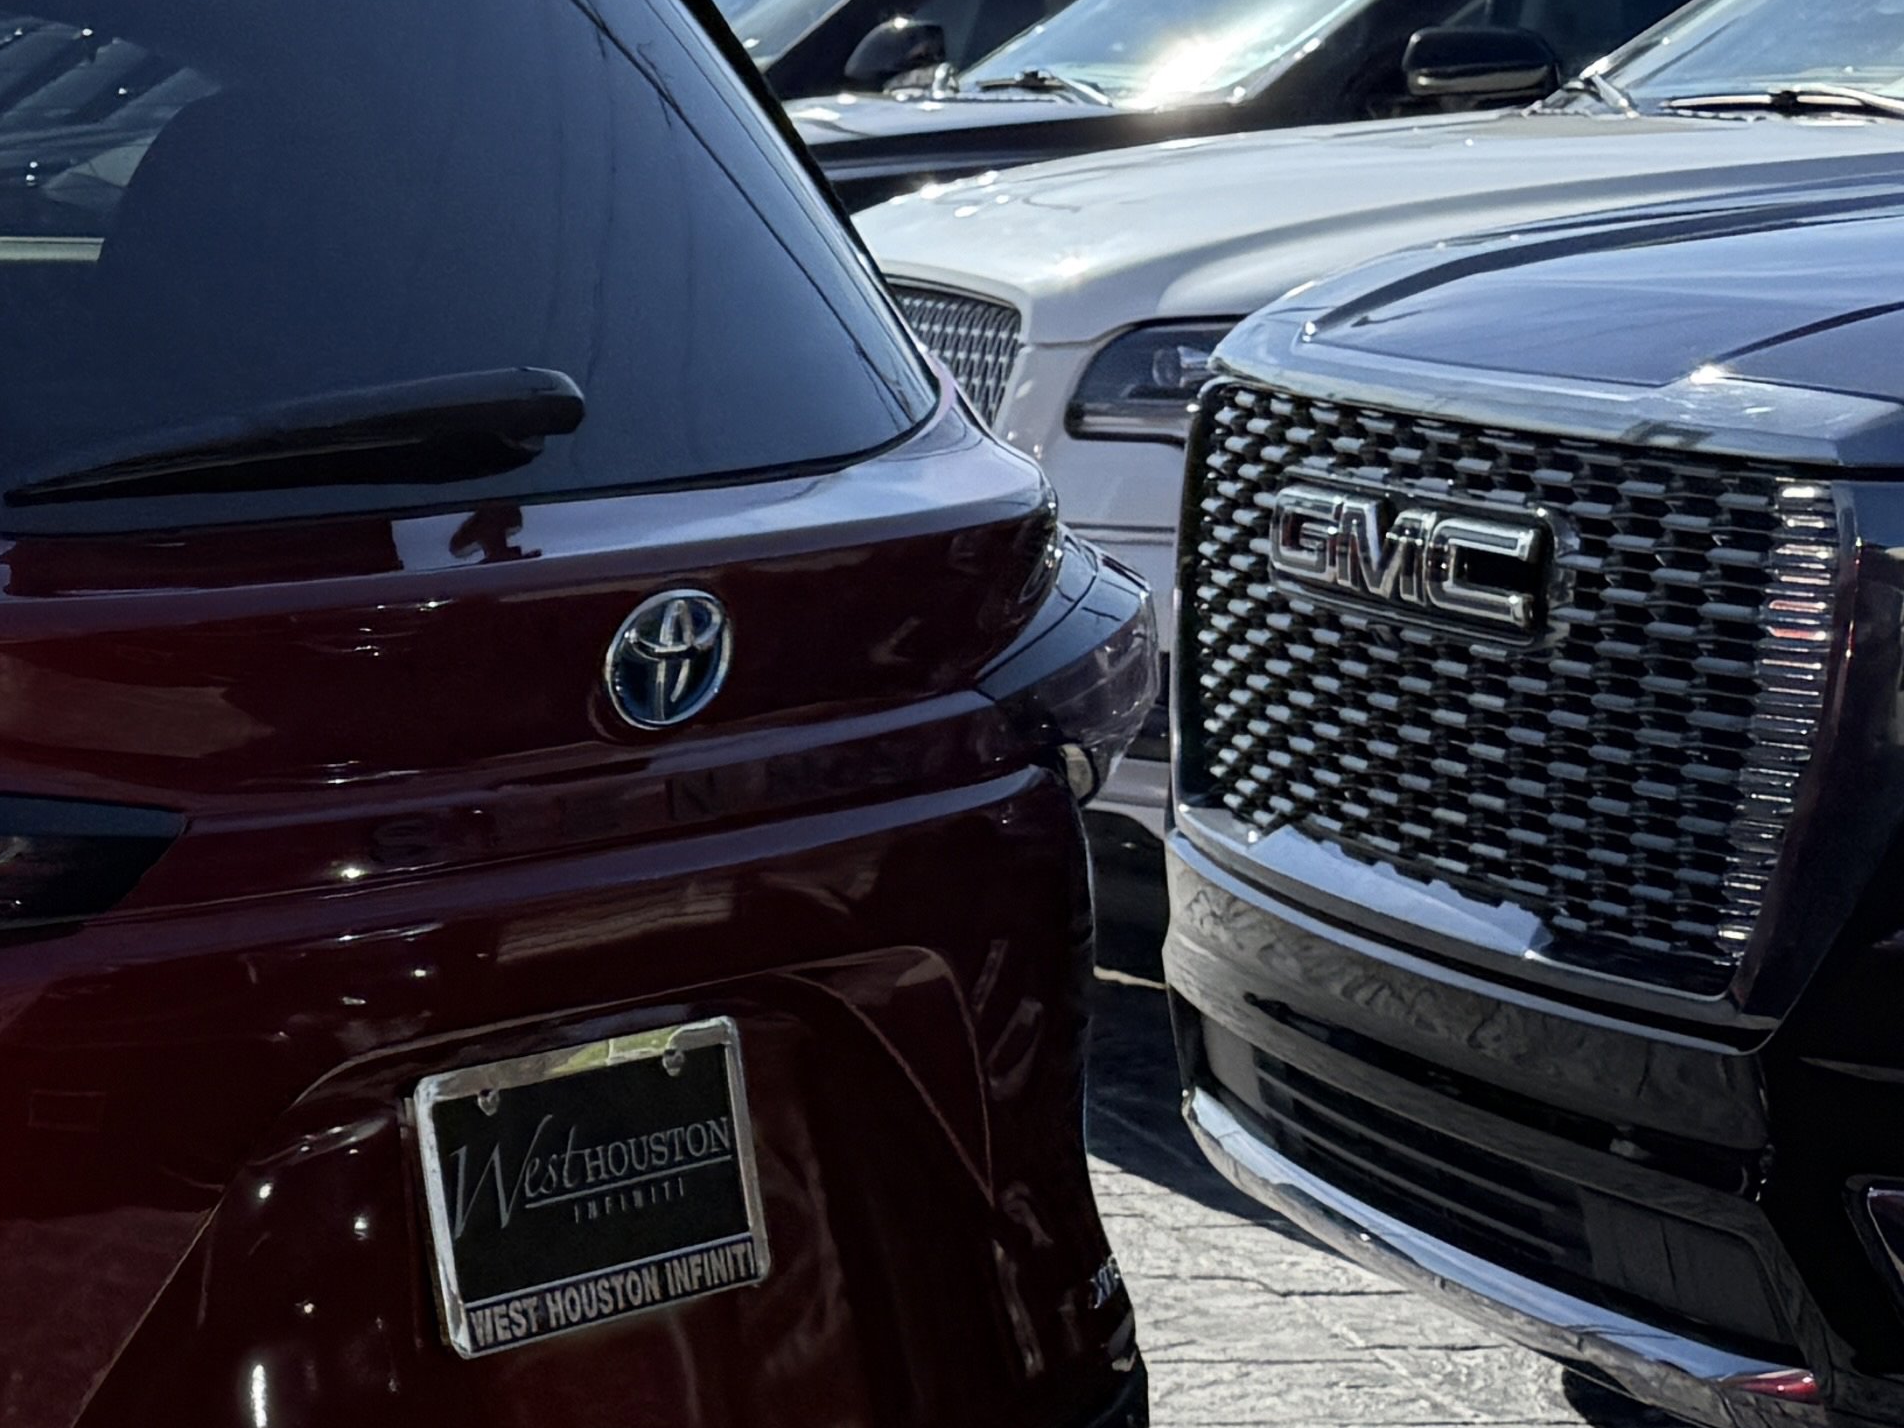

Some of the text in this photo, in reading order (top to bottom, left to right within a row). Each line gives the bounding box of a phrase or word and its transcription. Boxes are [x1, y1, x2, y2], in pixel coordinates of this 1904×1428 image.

[1270, 482, 1538, 629] GMC
[583, 1116, 732, 1183] HOUSTON
[574, 1177, 685, 1224] INFINITI
[470, 1241, 756, 1348] WEST HOUSTON INFINITI
